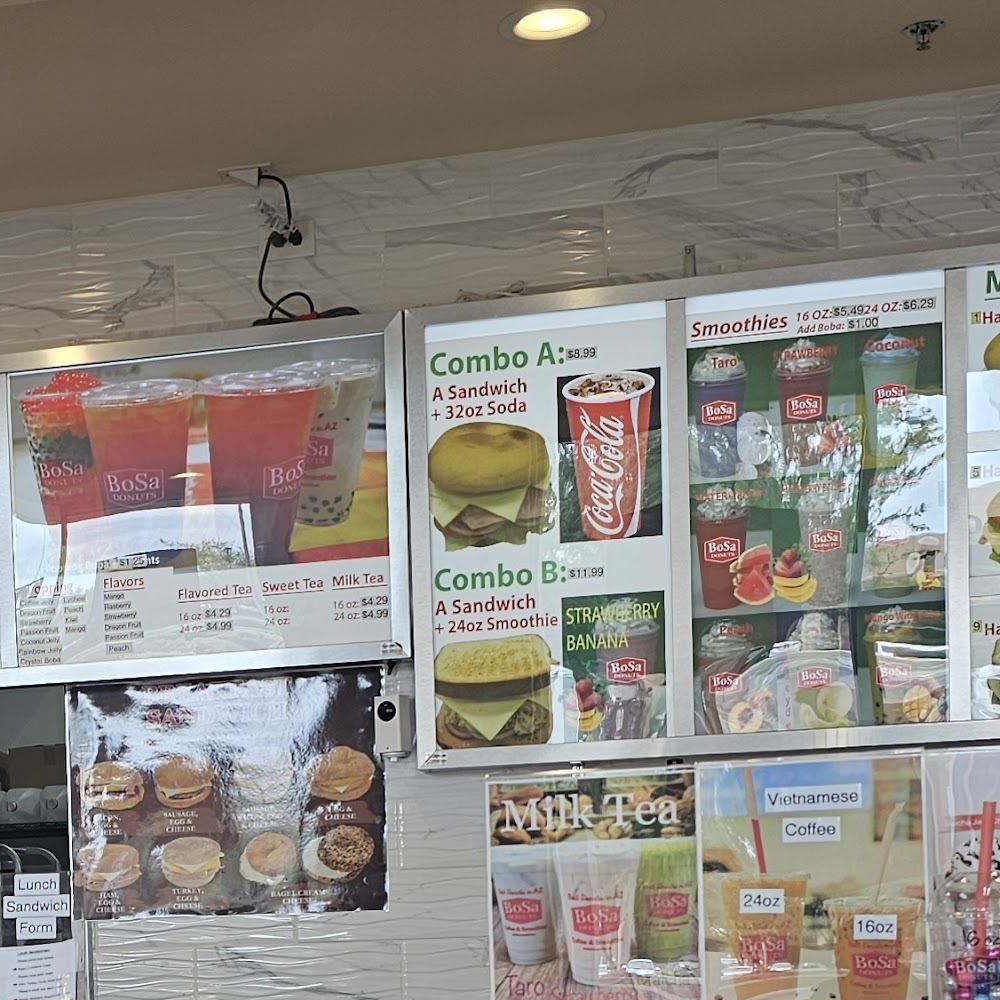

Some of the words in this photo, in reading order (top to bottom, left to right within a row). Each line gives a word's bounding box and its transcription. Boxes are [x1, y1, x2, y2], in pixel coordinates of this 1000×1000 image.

[691, 314, 788, 337] Smoothies
[796, 311, 809, 322] 16
[833, 305, 864, 318] $5.49
[903, 298, 934, 311] $6.29
[818, 321, 845, 332] Boba:
[848, 317, 879, 329] $1.00
[430, 345, 528, 377] Combo
[537, 341, 565, 366] A:
[567, 347, 596, 359] $8.99
[712, 356, 737, 369] Taro
[432, 386, 444, 401] A
[448, 378, 527, 401] Sandwich
[445, 404, 483, 420] 32oz
[487, 400, 527, 416] Soda
[38, 460, 84, 478] BoSa
[106, 472, 160, 493] BoSa
[112, 491, 157, 501] DONUTS
[708, 541, 738, 553] BoSa
[332, 574, 361, 587] Milk
[363, 572, 384, 584] Tea
[434, 563, 533, 592] Combo
[541, 560, 567, 585] B:
[569, 567, 604, 579] $11.99
[103, 576, 145, 589] Flavors
[262, 580, 301, 593] Sweet
[302, 577, 324, 589] Tea
[178, 585, 229, 600] Flavored
[231, 584, 253, 595] Tea
[362, 596, 388, 606] $4.29
[435, 600, 447, 616] A
[452, 593, 536, 615] Sandwich
[362, 609, 389, 619] $4.99
[566, 601, 661, 625] STRAWBERRY
[448, 618, 483, 634] 24oz
[487, 612, 558, 631] Smoothie
[108, 644, 130, 652] Peach
[566, 632, 629, 652] BANANA
[610, 660, 642, 674] BoSa
[767, 790, 859, 807] Vietnamese
[501, 792, 594, 833] Milk
[603, 792, 682, 828] Tea
[784, 822, 836, 837] Coffee
[17, 878, 57, 891] Lunch
[6, 900, 68, 913] Sandwich
[503, 900, 540, 914] BoSa
[742, 893, 781, 908] 24oz
[575, 907, 619, 925] BoSa
[19, 920, 53, 934] Form
[856, 919, 894, 935] 16oz
[854, 954, 897, 970] BoSa
[954, 960, 997, 974] BoSa
[505, 974, 545, 997] Taro
